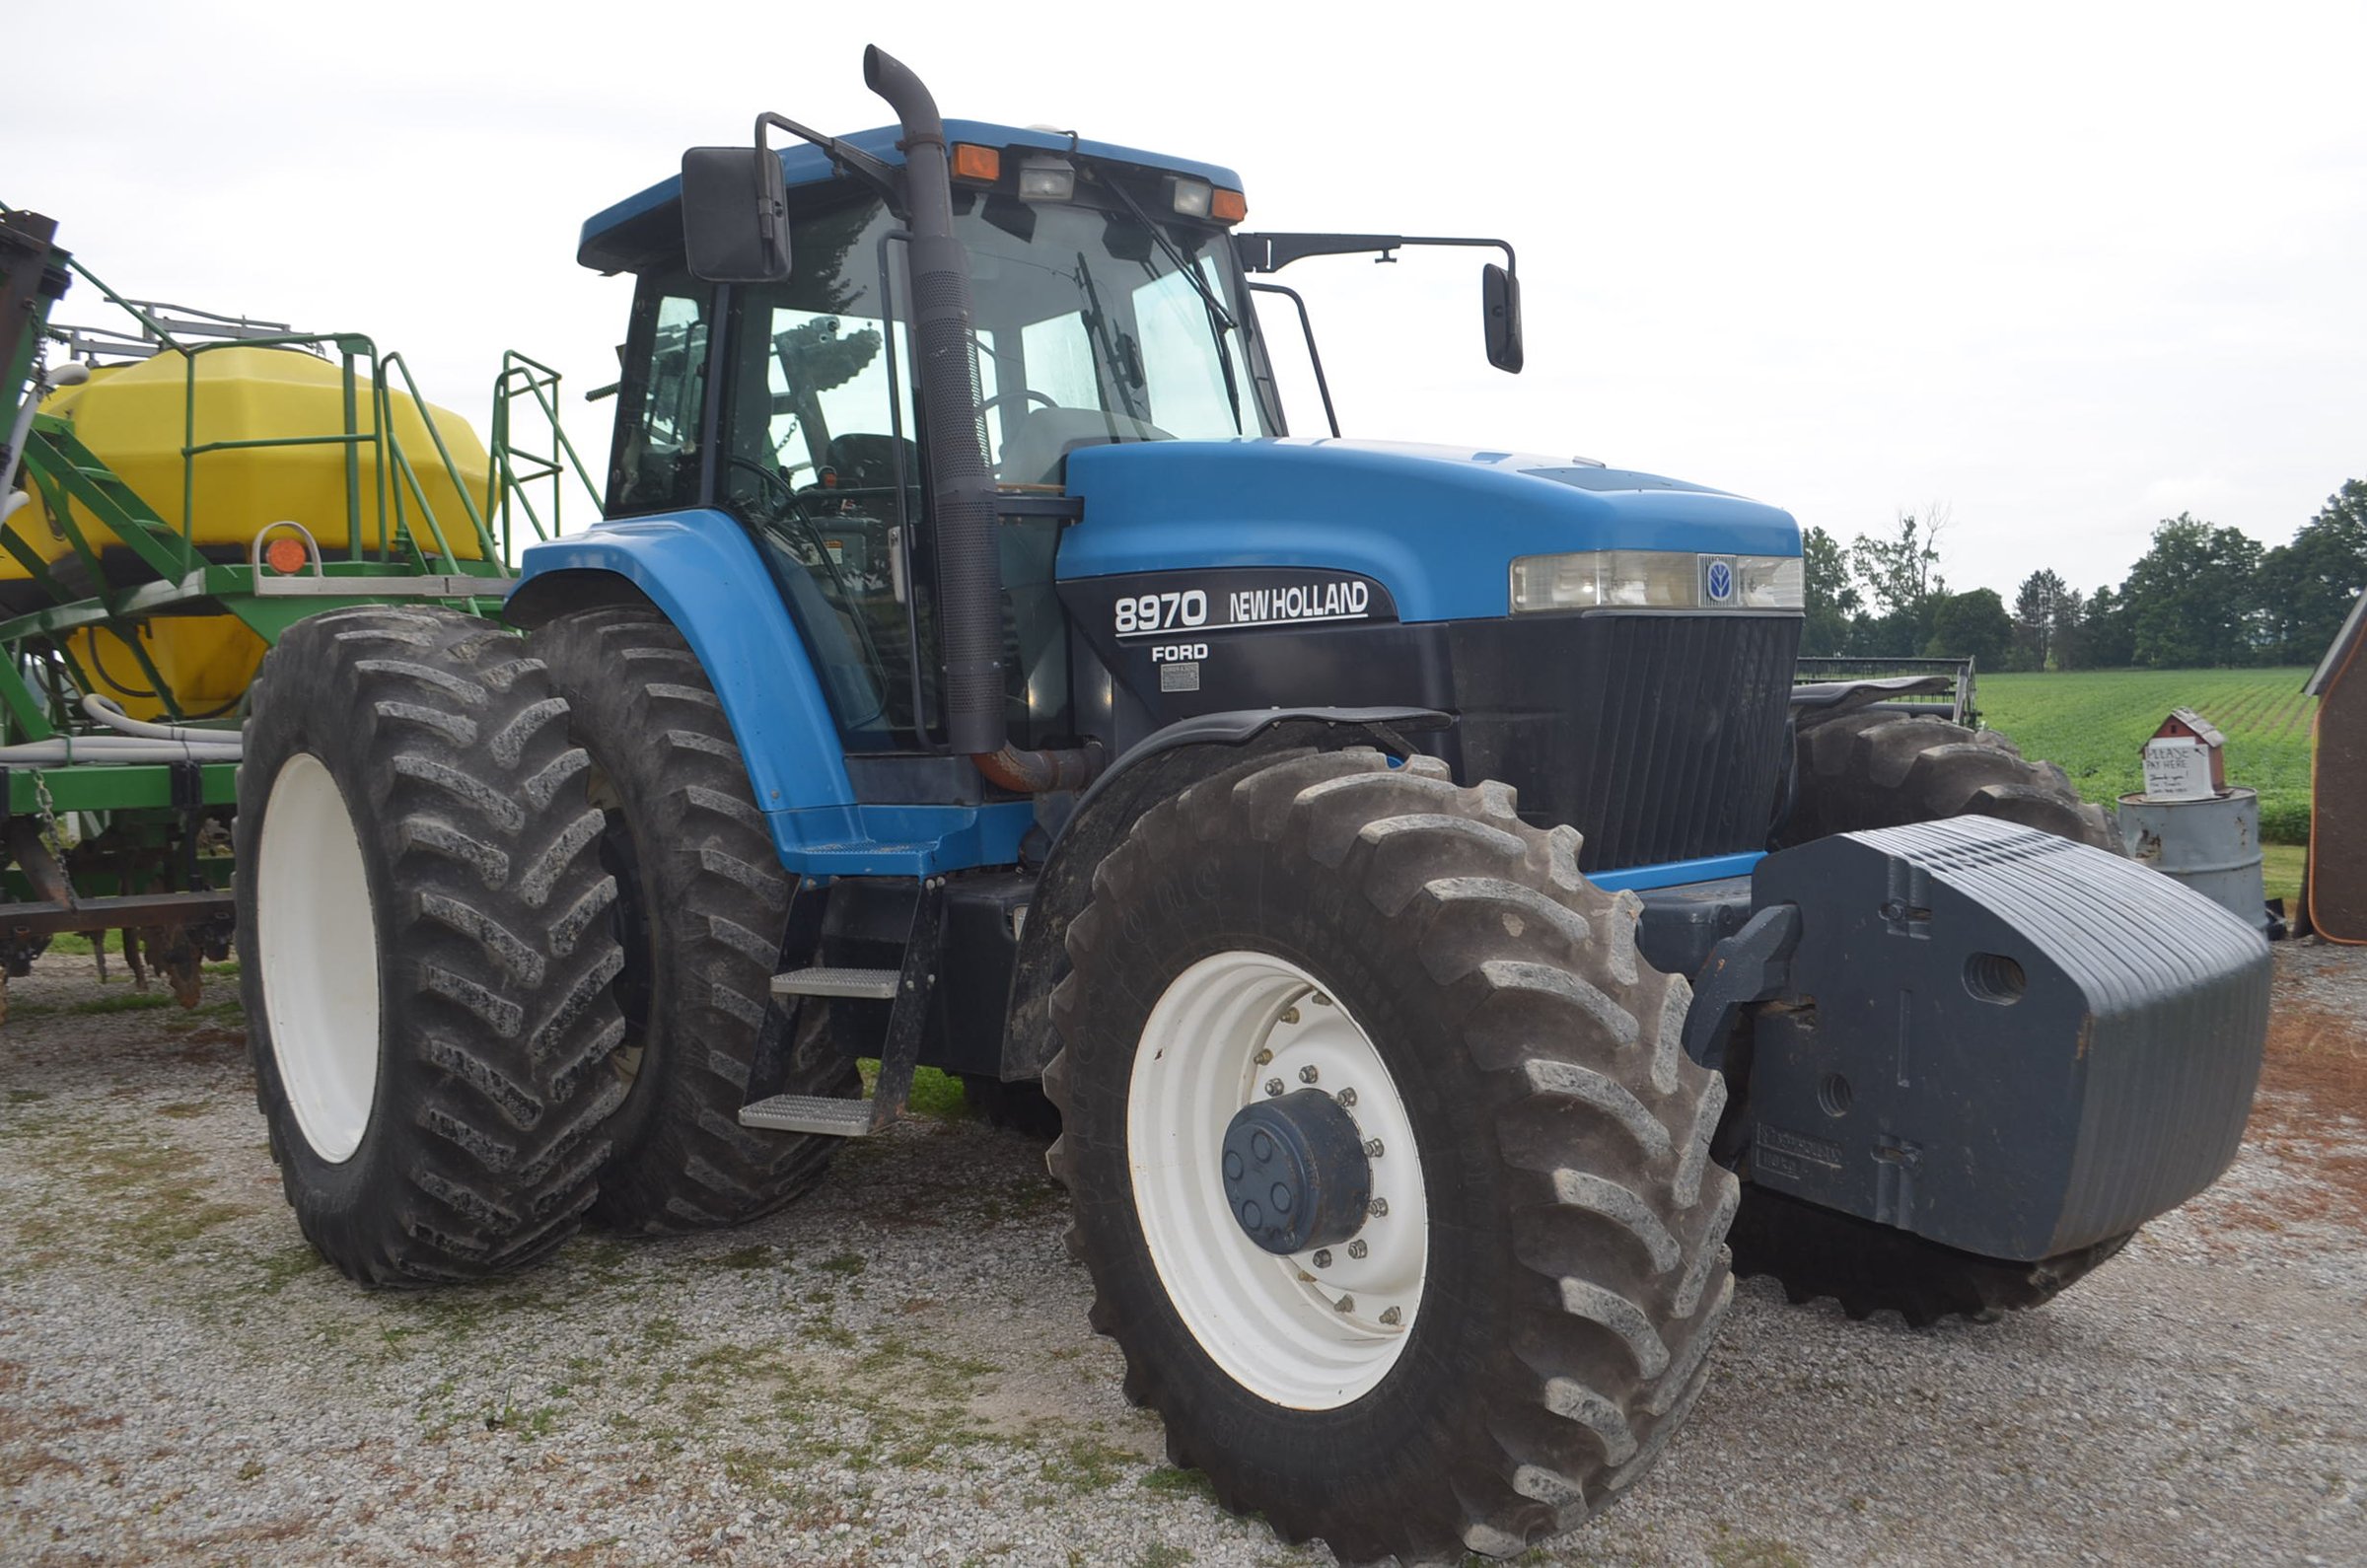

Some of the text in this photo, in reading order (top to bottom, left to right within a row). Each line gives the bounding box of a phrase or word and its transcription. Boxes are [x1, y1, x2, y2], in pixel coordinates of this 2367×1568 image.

[1114, 580, 1369, 633] 8970 NEW HOLLAND
[1152, 643, 1208, 663] FORD
[2146, 748, 2189, 759] PLEASE
[2146, 758, 2187, 769] PAY HERE
